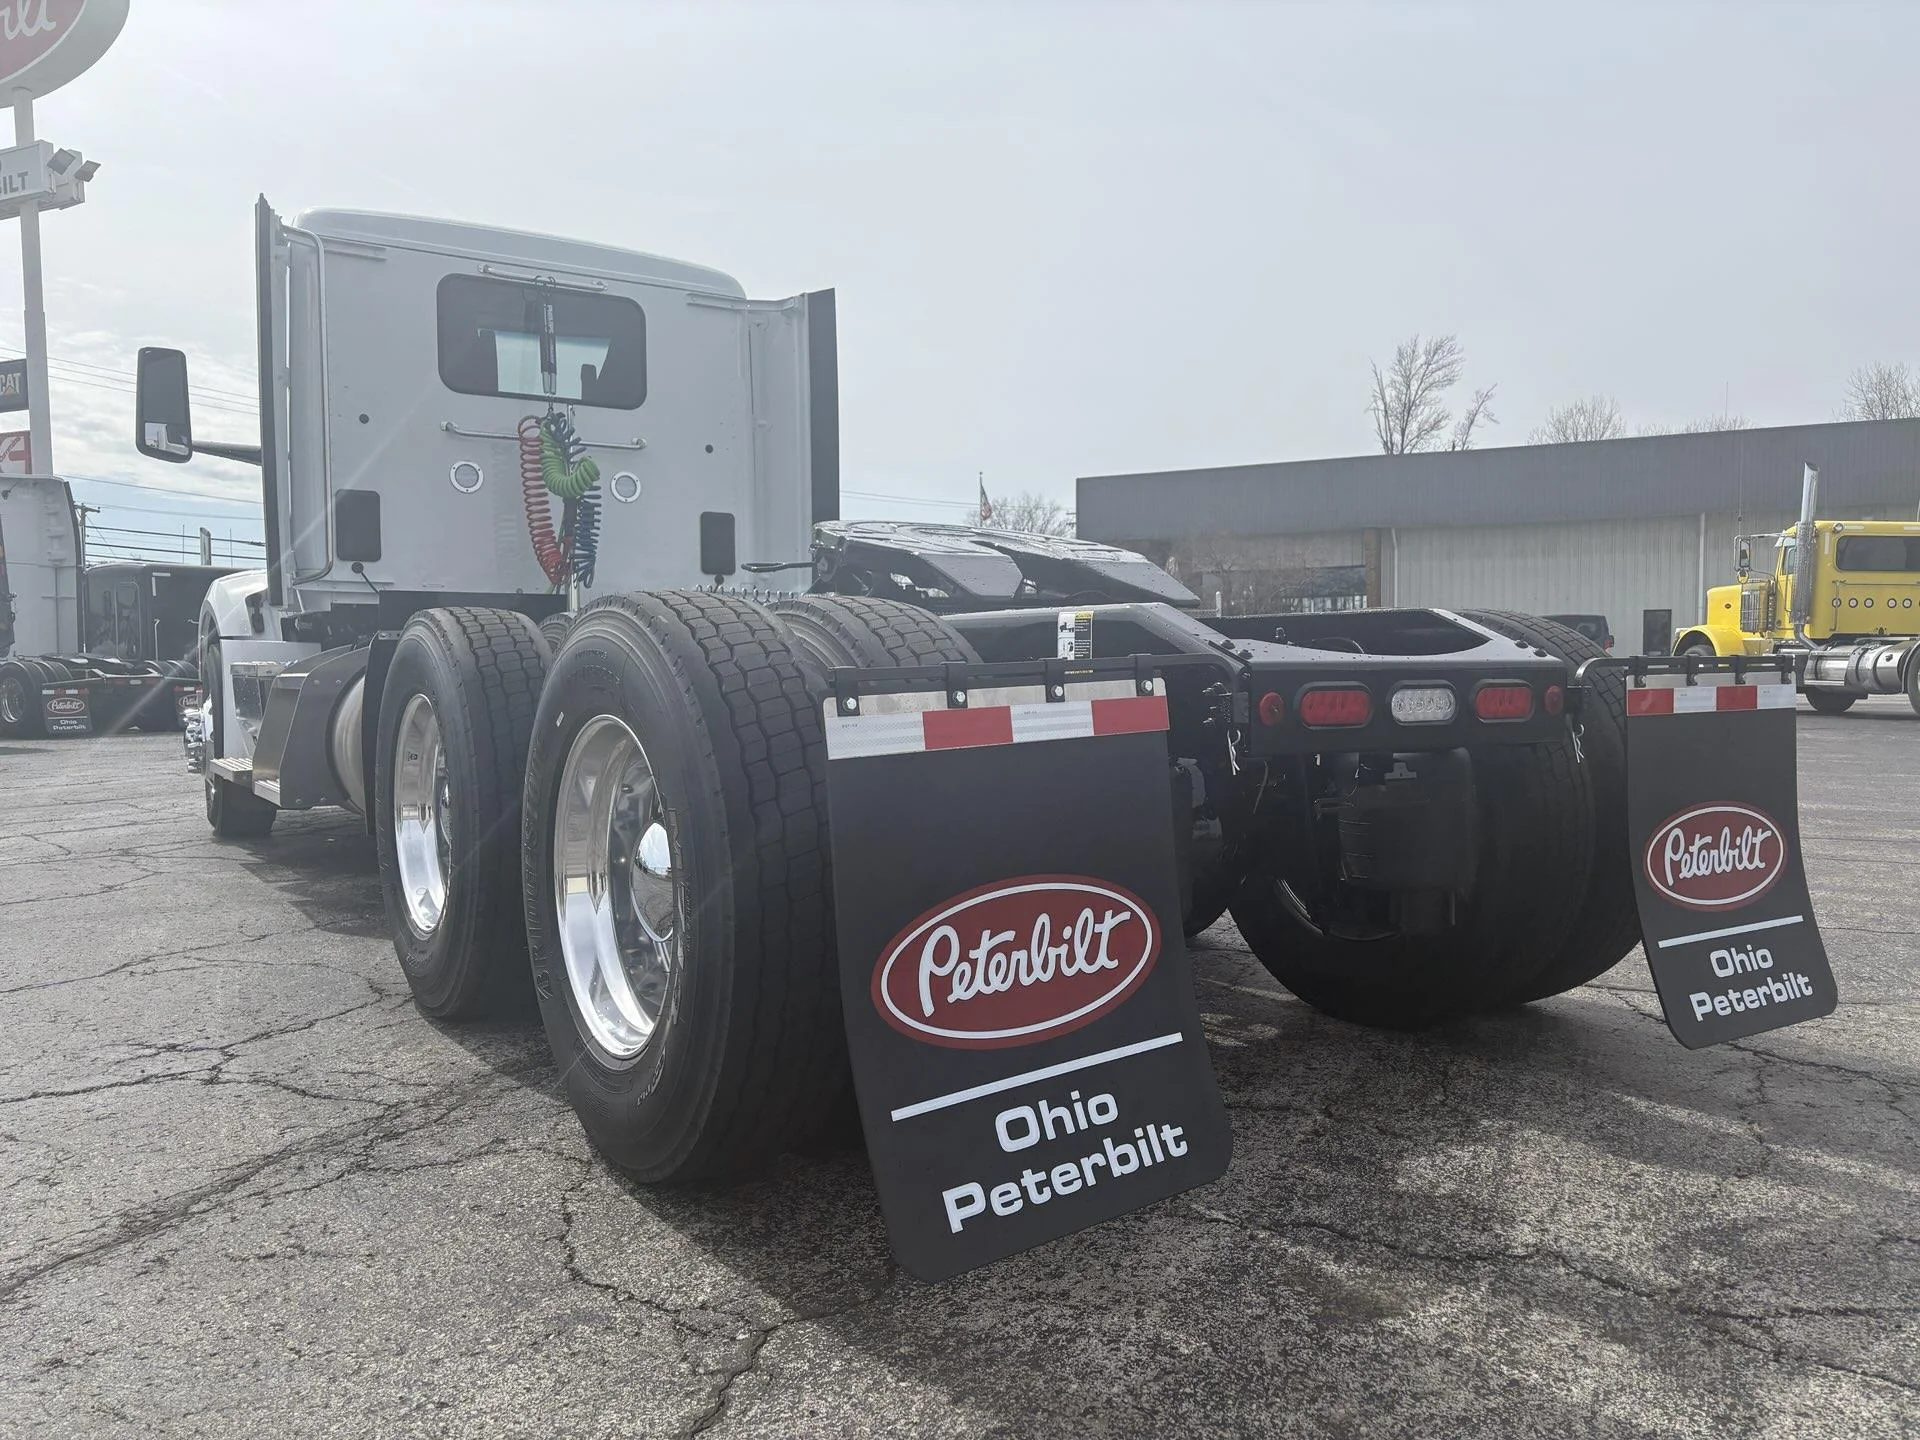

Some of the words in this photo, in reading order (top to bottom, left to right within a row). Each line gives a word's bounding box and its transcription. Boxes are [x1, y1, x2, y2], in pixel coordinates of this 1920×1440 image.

[0, 171, 29, 195] ILT
[1664, 825, 1772, 886] Peterbilt
[918, 907, 1131, 1017] Peterbilt
[1709, 944, 1774, 978] Ohio
[1689, 972, 1813, 1022] Peterbilt
[995, 1090, 1119, 1153] Ohio
[942, 1123, 1188, 1234] Peterbilt
